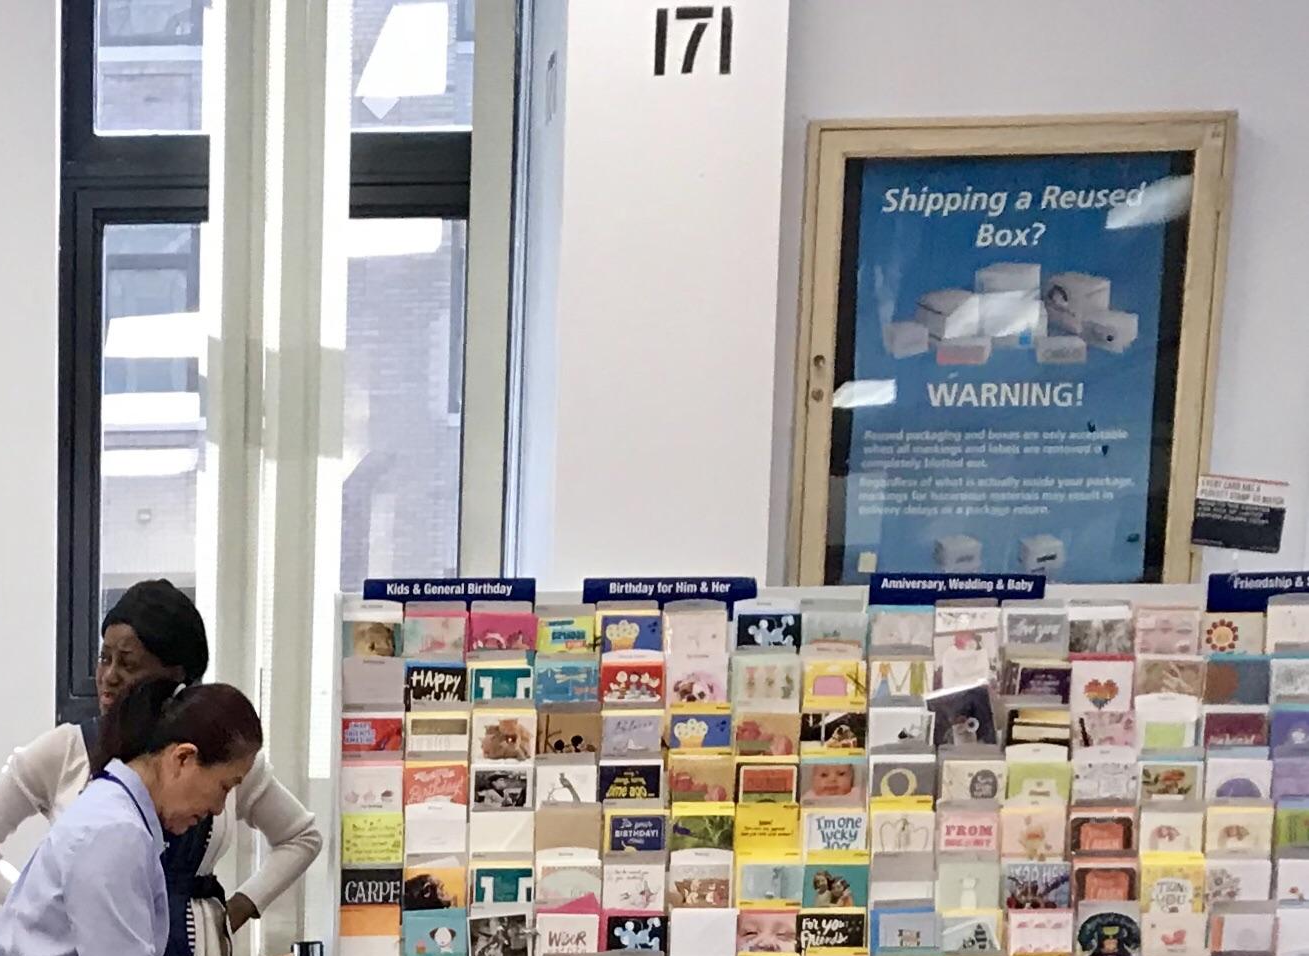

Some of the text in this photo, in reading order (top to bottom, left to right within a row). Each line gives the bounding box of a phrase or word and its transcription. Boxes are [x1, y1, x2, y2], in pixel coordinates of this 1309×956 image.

[654, 6, 733, 76] 171
[881, 181, 1147, 217] Shipping a Reused
[975, 222, 1046, 247] Box?
[927, 381, 1085, 407] WARNING!
[906, 430, 962, 442] packaging
[964, 429, 986, 440] and
[1042, 430, 1067, 442] only
[965, 444, 986, 454] and
[935, 477, 963, 487] what
[1057, 478, 1084, 489] your
[911, 491, 927, 501] for
[1042, 492, 1066, 503] may
[386, 582, 513, 597] Kids & General Birthday
[609, 582, 731, 596] Birthday for Him & Her
[881, 577, 1035, 593] Anniversary, Wedding & Baby
[1233, 576, 1293, 589] Friendship
[1294, 576, 1304, 588] &
[816, 816, 862, 830] I'm one
[614, 829, 659, 838] BIRTHDAY!
[820, 829, 859, 844] lucky
[344, 880, 401, 904] CARPE
